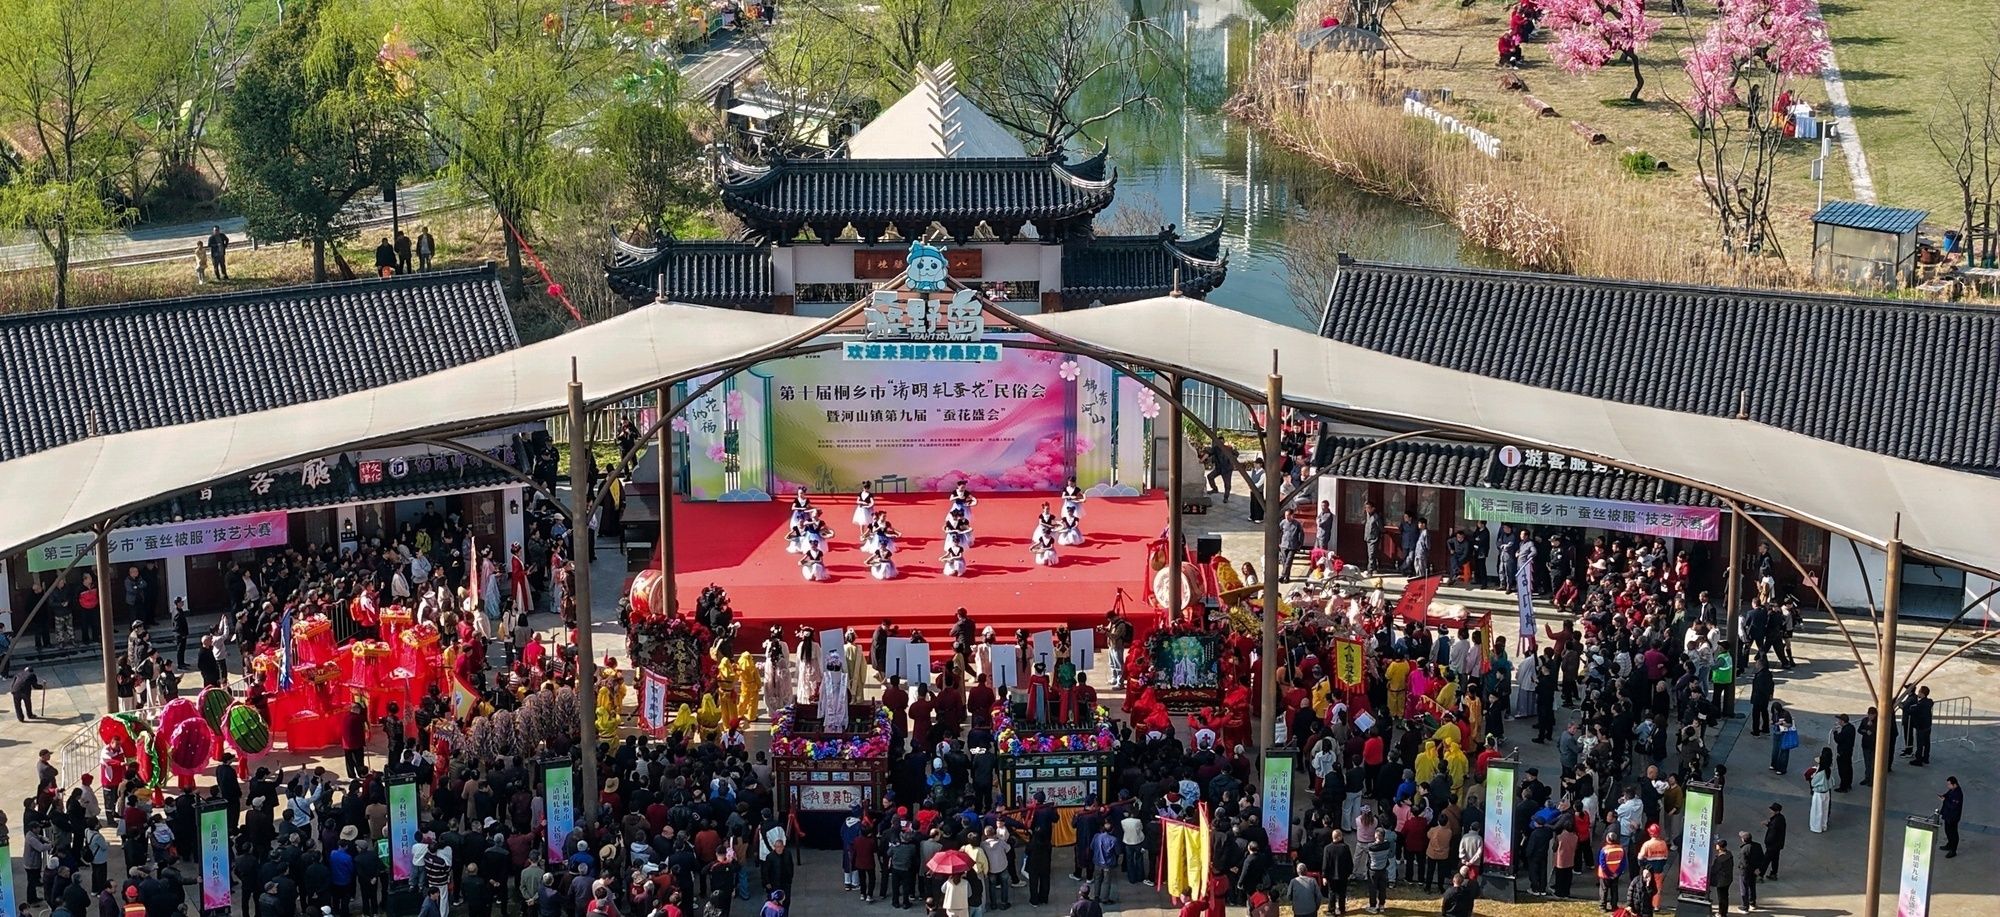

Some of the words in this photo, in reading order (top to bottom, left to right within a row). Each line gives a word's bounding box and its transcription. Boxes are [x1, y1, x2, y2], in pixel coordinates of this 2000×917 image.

[43, 522, 273, 561] 第三届乡市“蚕丝被服”技艺大赛
